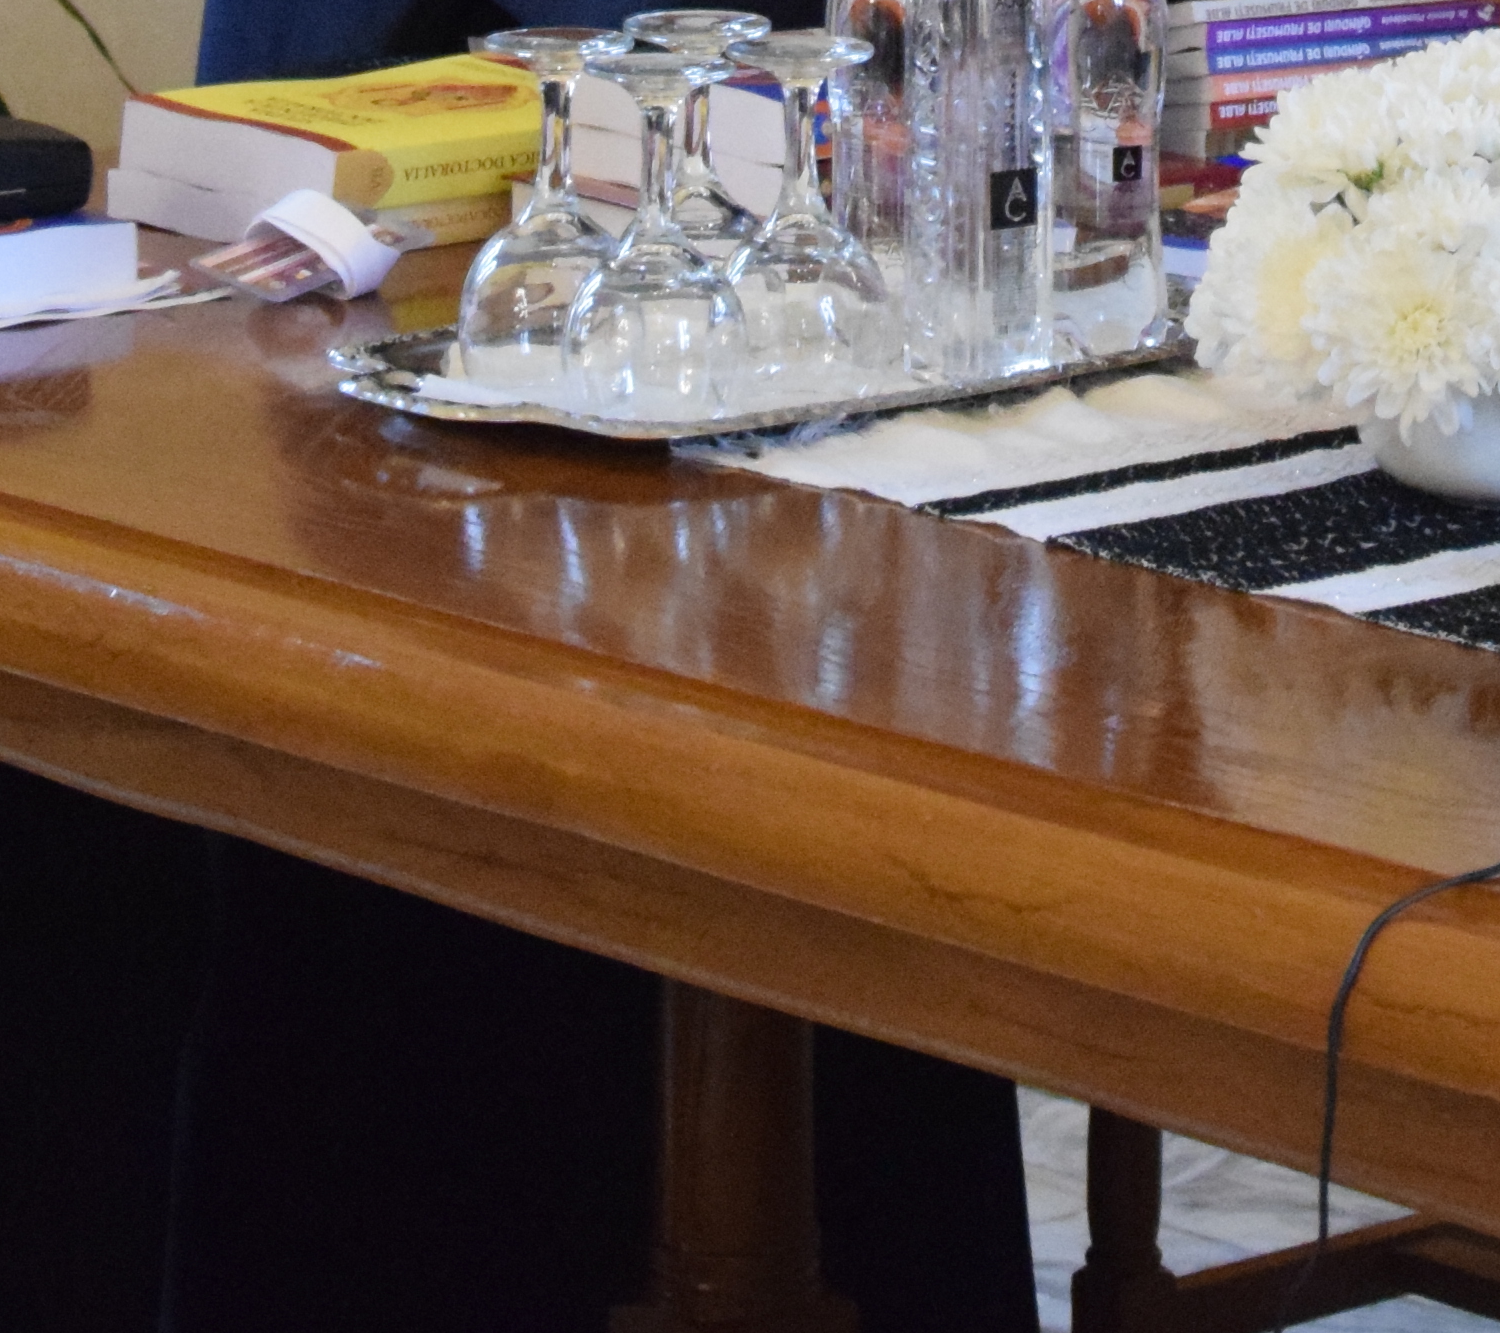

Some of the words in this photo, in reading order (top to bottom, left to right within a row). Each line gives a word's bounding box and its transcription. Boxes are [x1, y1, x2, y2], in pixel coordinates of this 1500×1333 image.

[1307, 21, 1321, 34] DE
[1216, 29, 1244, 43] ALBE
[1306, 47, 1321, 61] DE
[1216, 54, 1244, 69] ALBE
[1218, 104, 1246, 118] ALBE
[403, 156, 504, 182] DOCTORALIA
